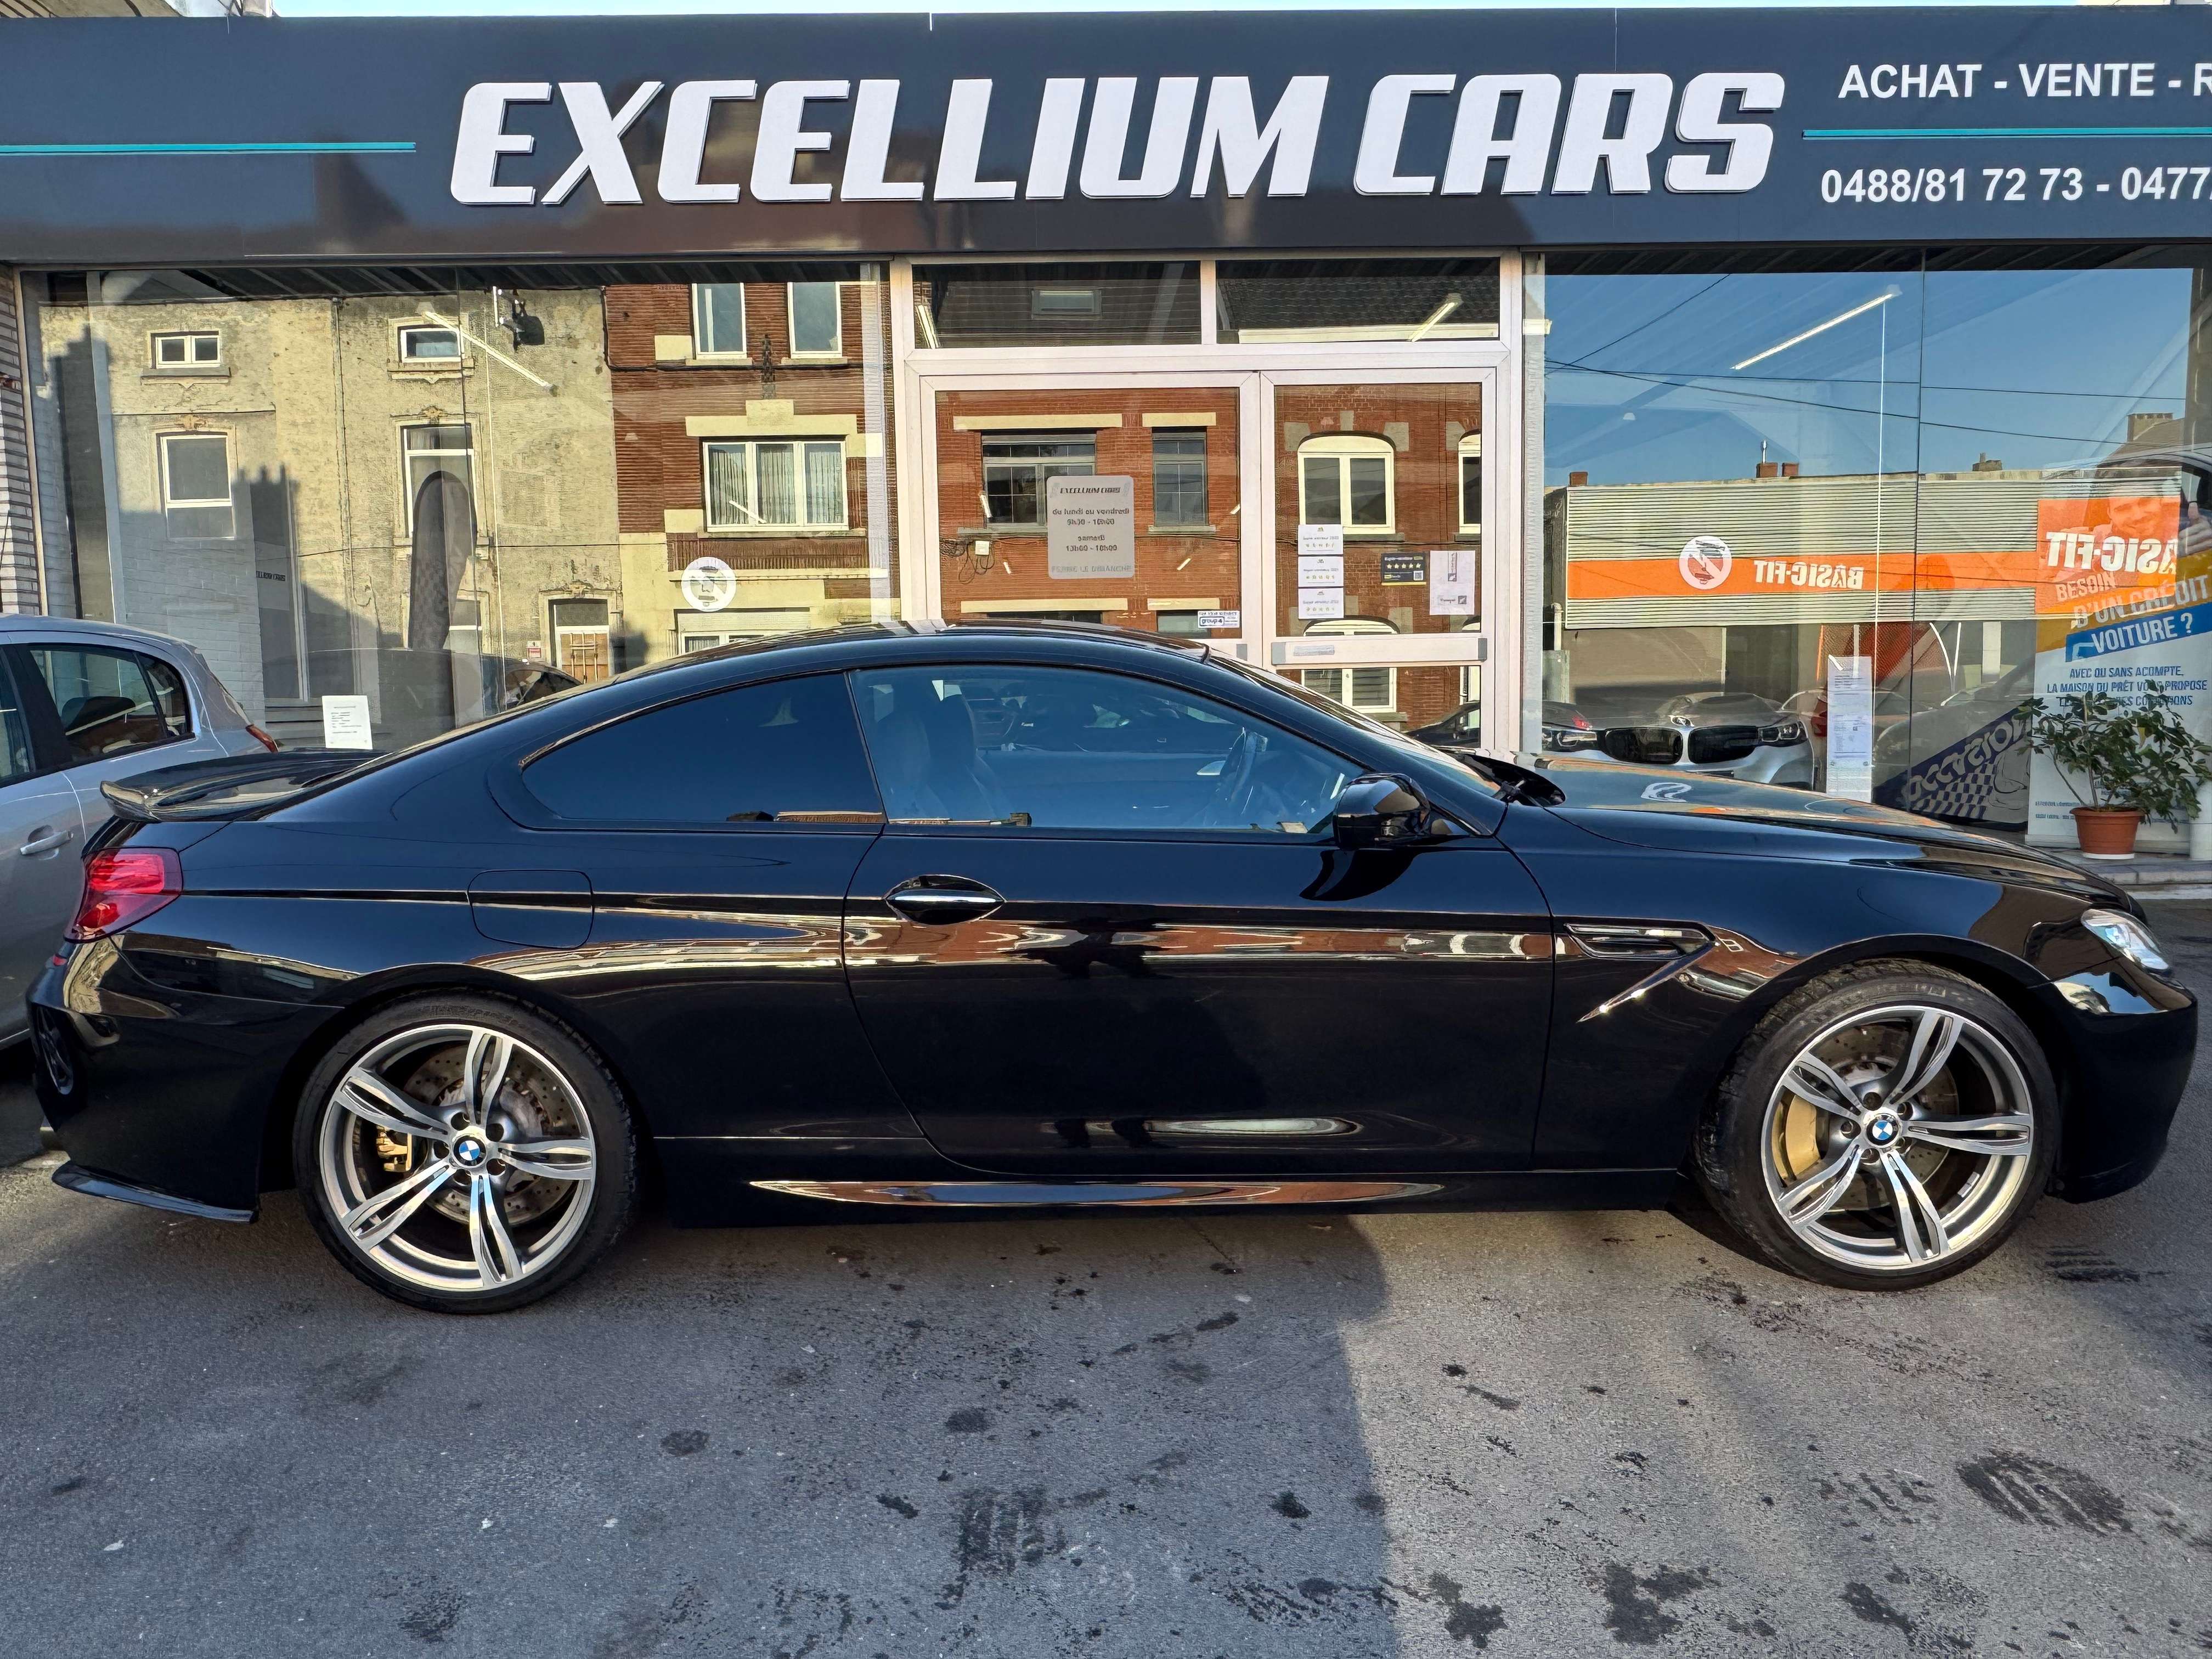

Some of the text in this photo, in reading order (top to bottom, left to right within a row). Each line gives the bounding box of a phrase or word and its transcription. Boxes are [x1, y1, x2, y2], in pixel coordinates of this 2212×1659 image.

[1838, 64, 1982, 98] ACHAT
[2018, 63, 2155, 97] VENTE
[450, 72, 1786, 205] EXCELLIUM CARS
[1821, 168, 1965, 203] 0488/81
[1983, 168, 2025, 201] 72
[2039, 167, 2083, 201] 73
[2121, 167, 2212, 200] 0477
[2056, 571, 2117, 602] BESOIN
[2091, 612, 2193, 653] VOITURE ?
[2047, 684, 2058, 693] LA
[2061, 682, 2094, 693] MAISON
[2097, 682, 2108, 692] DU
[2165, 680, 2207, 691] PROPOSE
[2070, 668, 2092, 679] AVEC
[2095, 668, 2107, 677] OU
[2109, 667, 2133, 677] SANS
